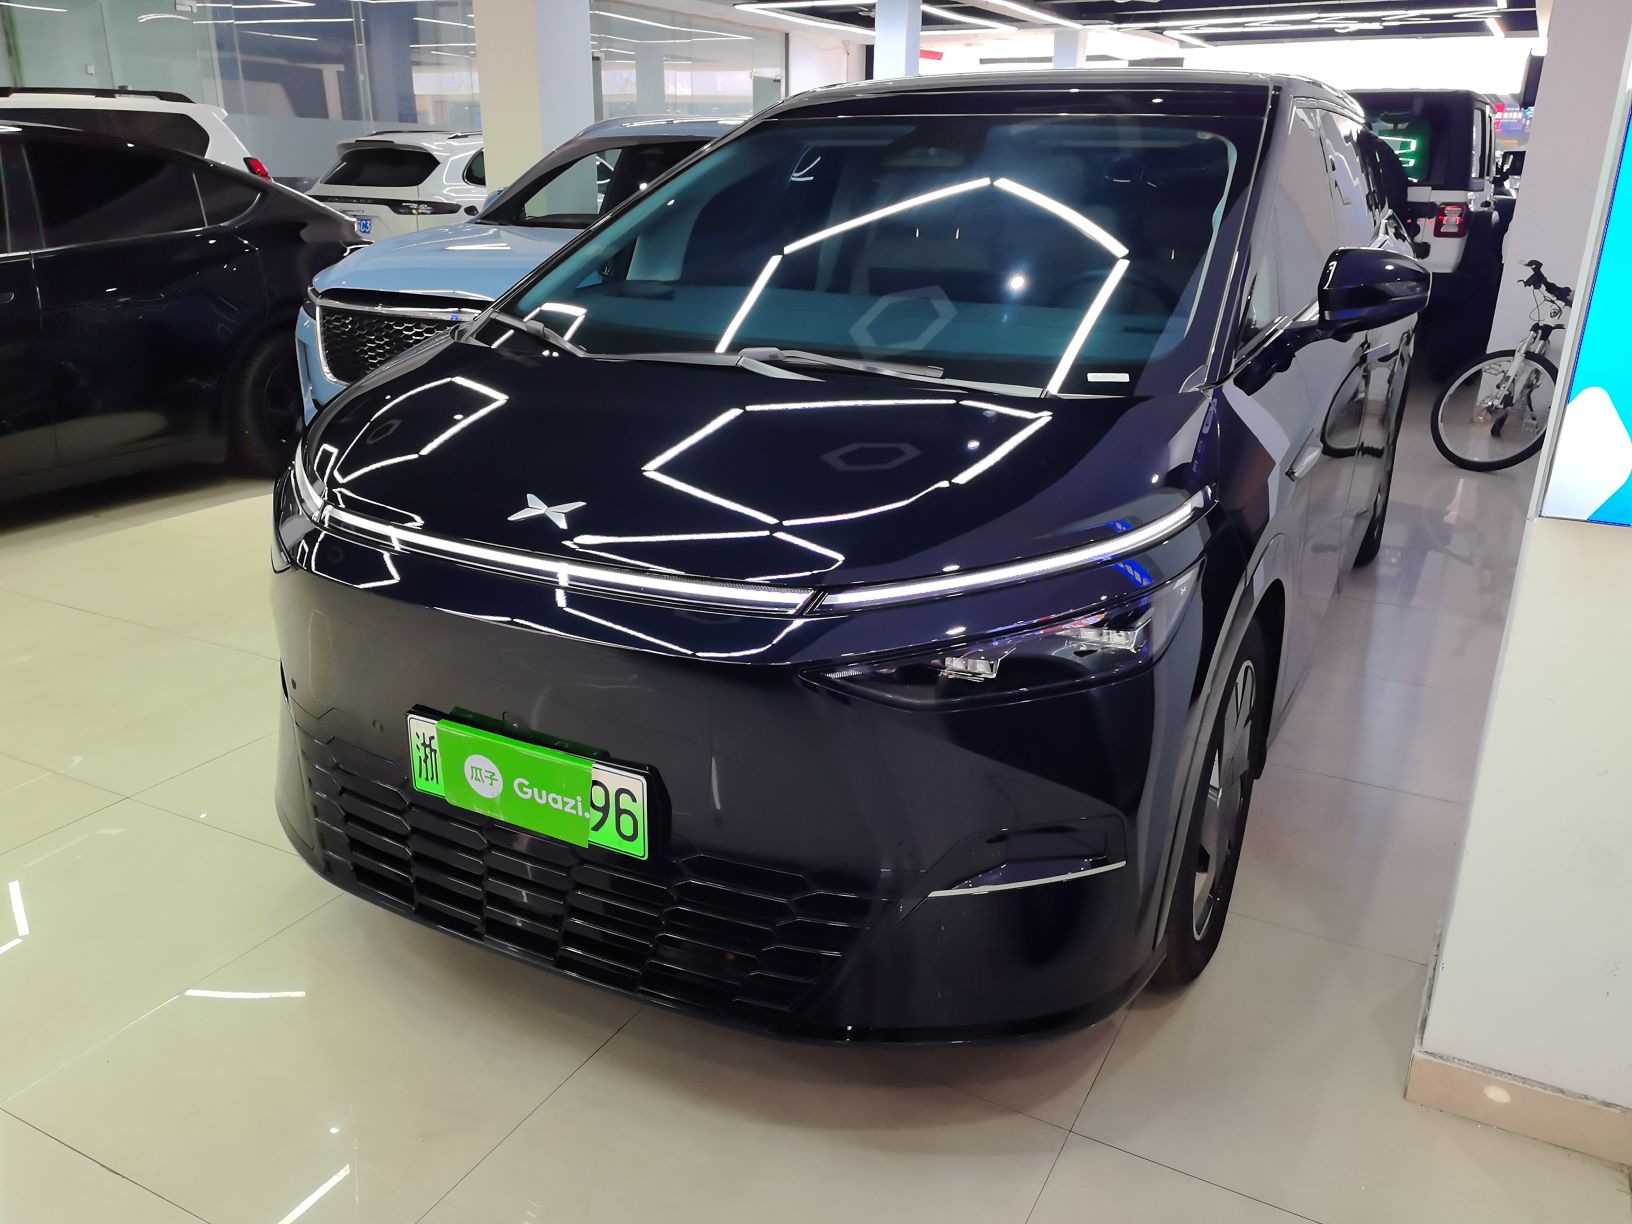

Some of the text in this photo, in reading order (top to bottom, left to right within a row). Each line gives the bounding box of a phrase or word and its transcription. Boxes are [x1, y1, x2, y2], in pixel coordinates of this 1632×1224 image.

[415, 731, 640, 843] 浙 96
[470, 765, 499, 787] 瓜子
